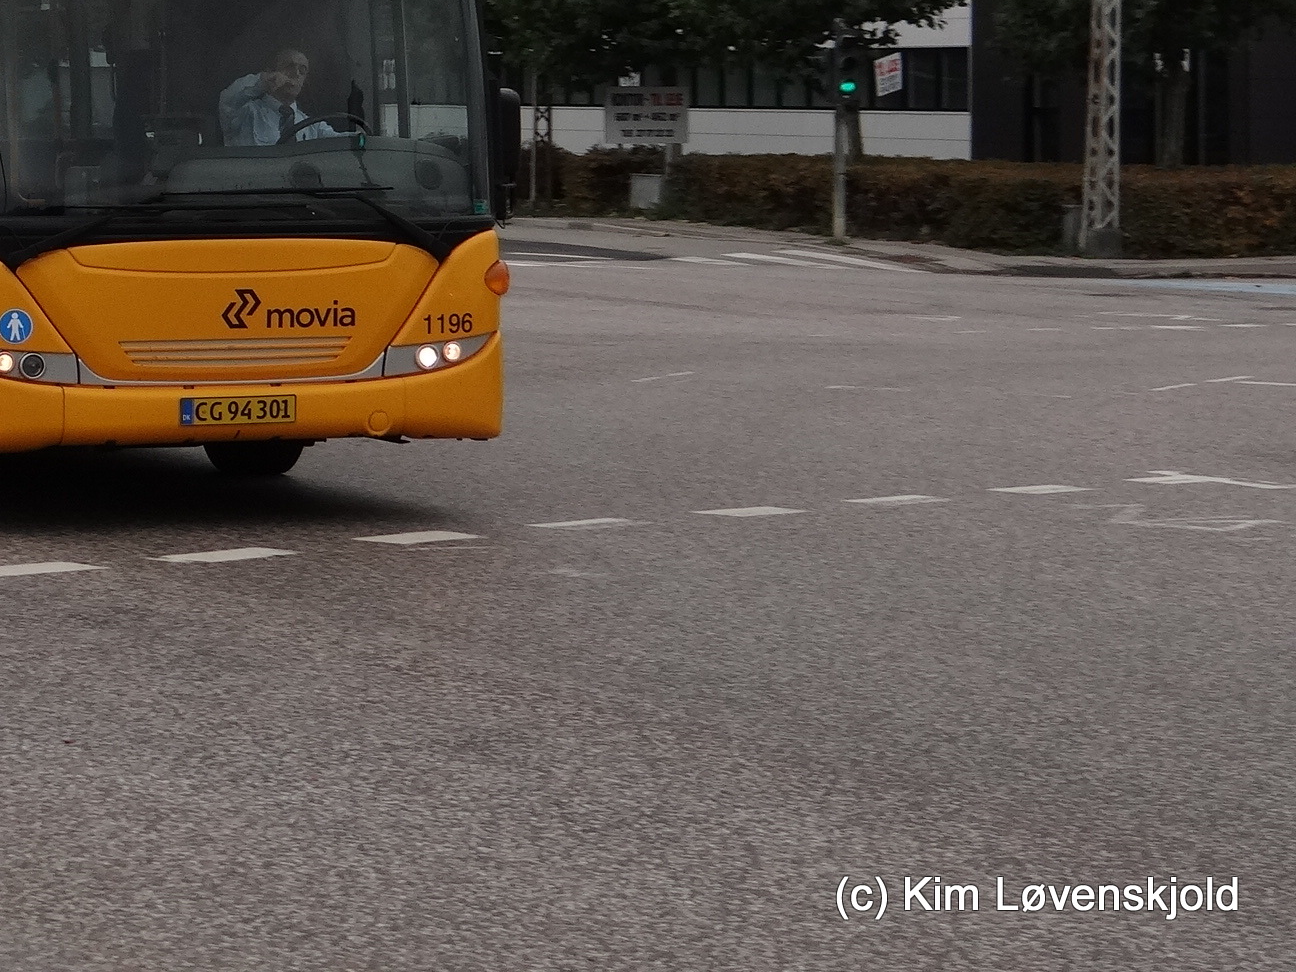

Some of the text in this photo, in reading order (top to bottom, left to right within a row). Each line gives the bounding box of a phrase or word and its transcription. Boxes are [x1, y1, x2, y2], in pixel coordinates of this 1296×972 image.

[266, 300, 356, 328] movia
[423, 313, 473, 334] 1196
[195, 401, 223, 421] CG
